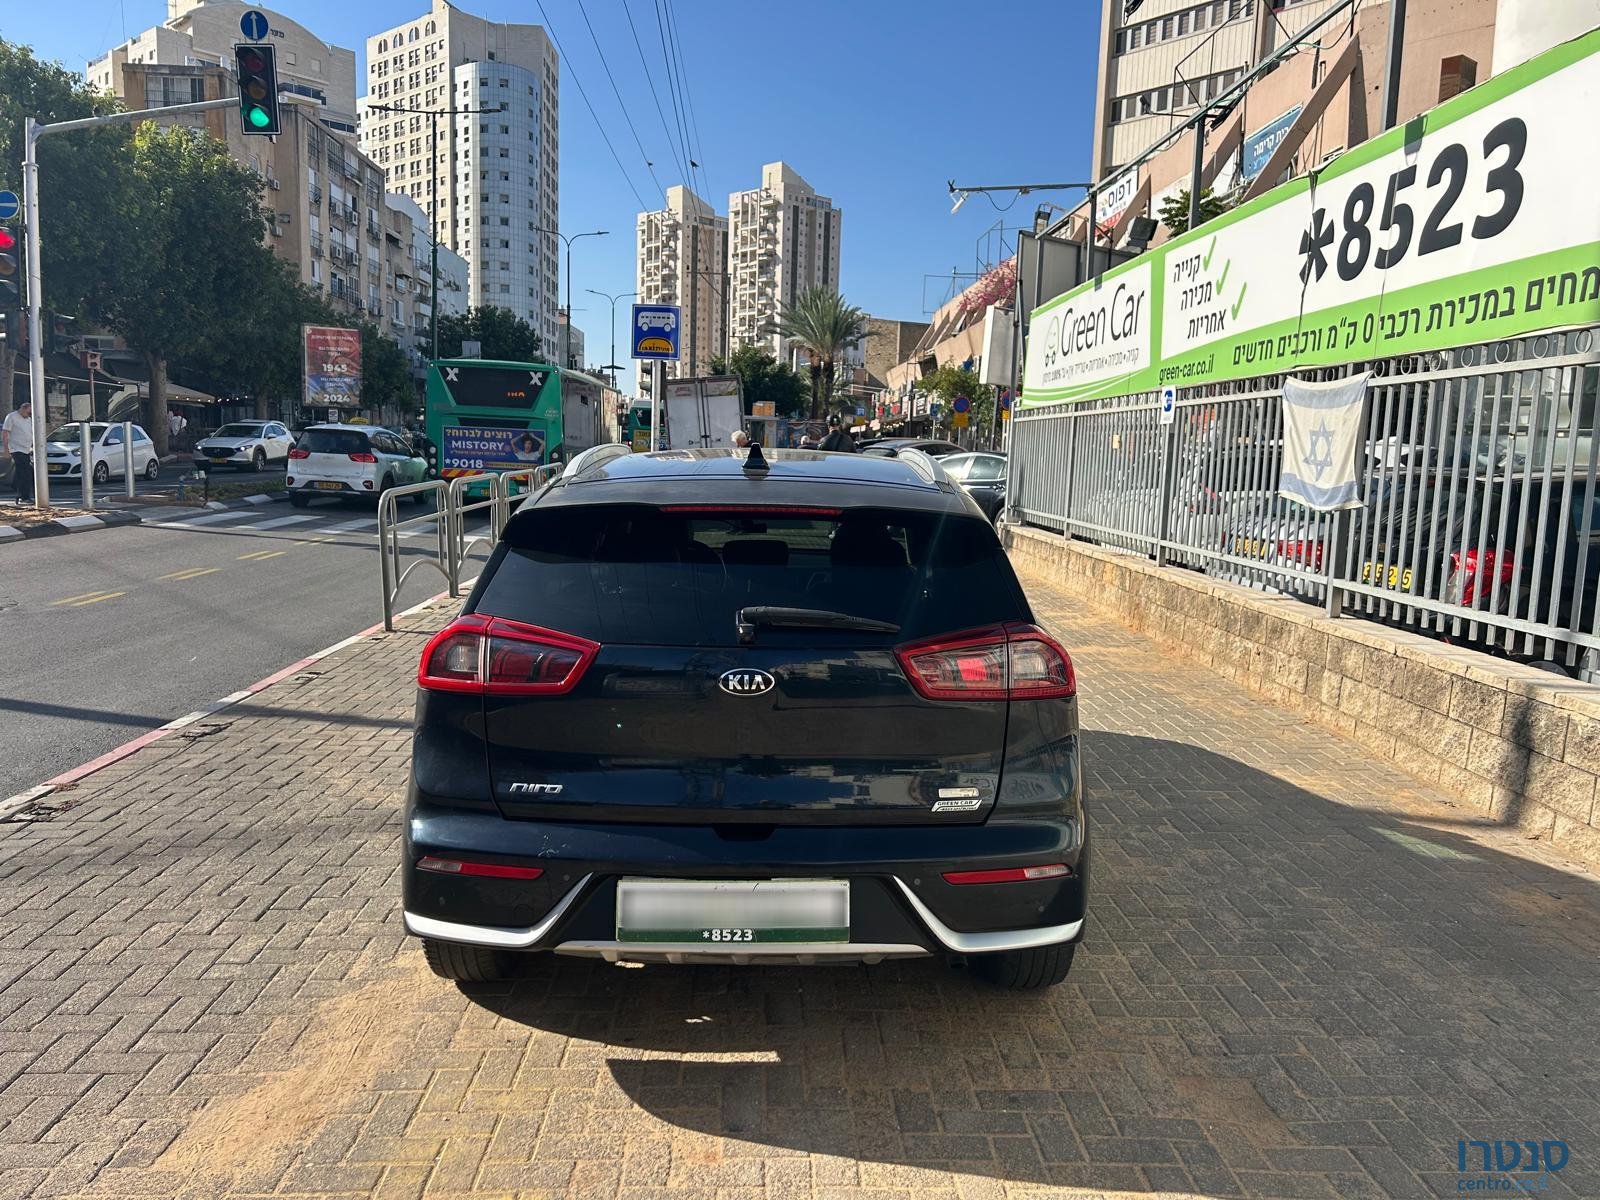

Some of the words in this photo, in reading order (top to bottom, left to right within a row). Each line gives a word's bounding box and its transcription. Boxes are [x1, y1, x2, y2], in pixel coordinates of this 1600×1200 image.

[1108, 178, 1132, 208] דפוס
[1173, 254, 1201, 283] קנייה
[1180, 281, 1213, 311] מכירה
[1425, 286, 1516, 332] במכירת
[1061, 307, 1106, 357] Green
[1110, 283, 1145, 341] Car
[1187, 308, 1227, 340] אחריות
[1379, 307, 1421, 340] רכבי
[1233, 339, 1274, 366] חדשים
[1277, 328, 1323, 358] ורכבים
[322, 363, 348, 372] 1945
[1159, 353, 1215, 386] green-car.co.il
[324, 394, 351, 403] 2024
[451, 440, 504, 451] MISTORY
[484, 430, 513, 439] רוצים
[727, 674, 766, 690] KIA
